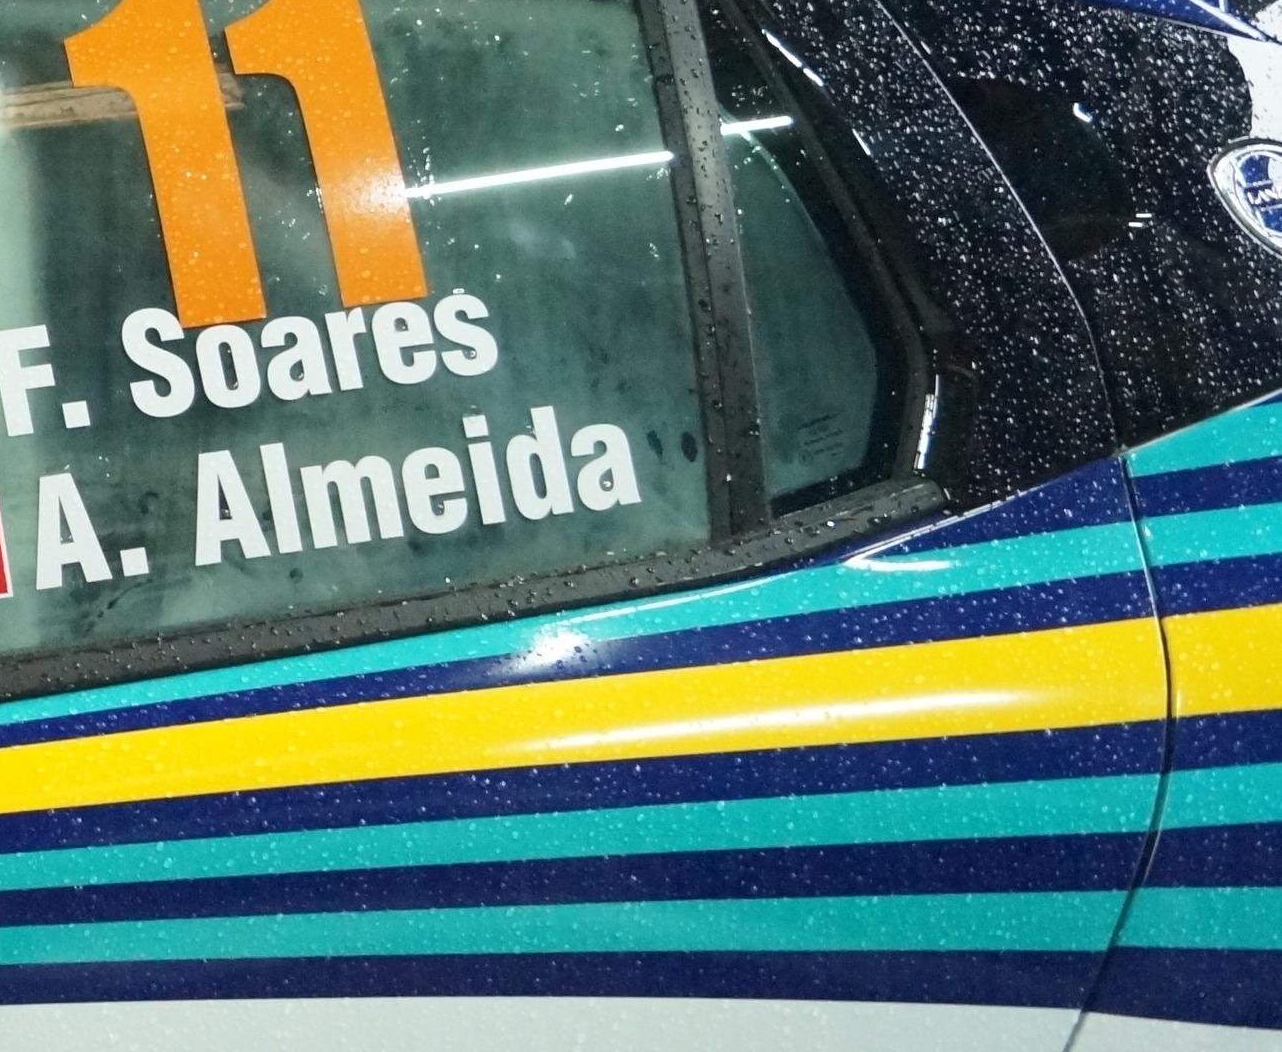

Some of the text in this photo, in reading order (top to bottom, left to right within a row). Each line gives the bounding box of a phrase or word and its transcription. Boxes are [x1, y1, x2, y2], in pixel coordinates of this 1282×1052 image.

[120, 292, 499, 419] Soares
[37, 406, 641, 590] A. Almeida
